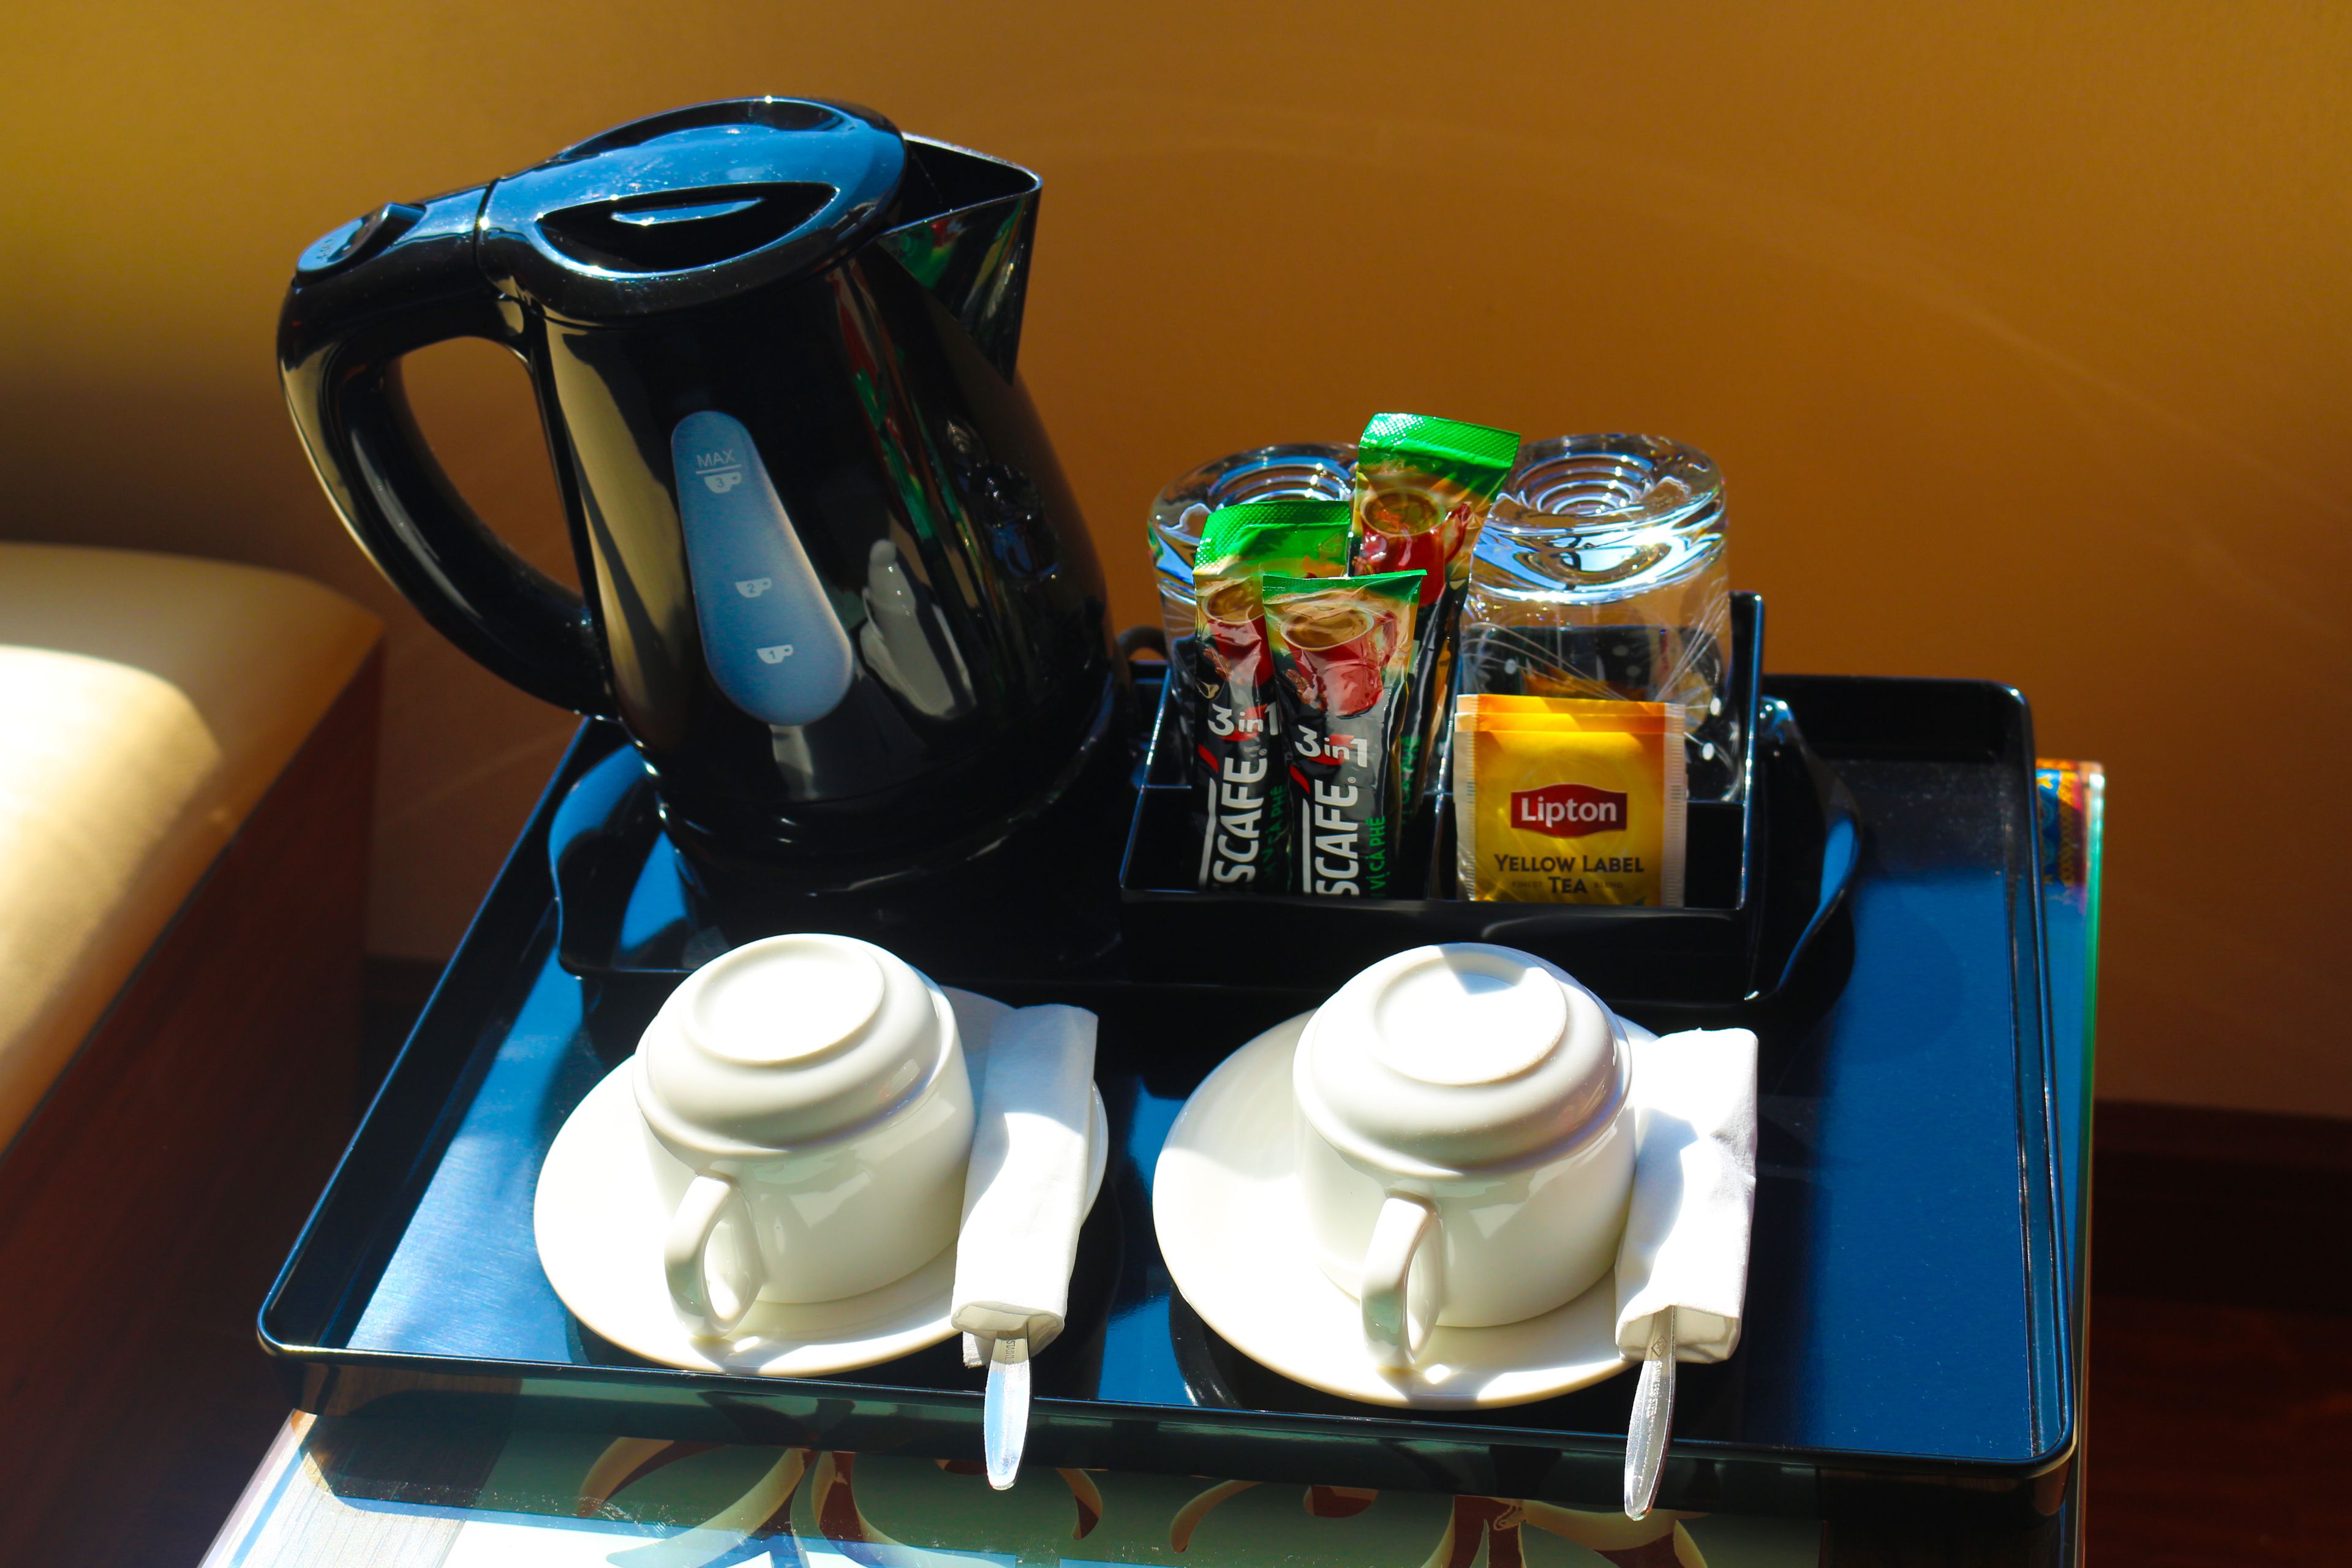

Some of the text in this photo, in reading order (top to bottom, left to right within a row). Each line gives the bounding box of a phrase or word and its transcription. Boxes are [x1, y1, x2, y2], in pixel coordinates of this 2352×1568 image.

[696, 449, 736, 469] MAX
[716, 477, 725, 489] 3
[746, 582, 756, 594] 2
[1202, 747, 1268, 884] SCAFÉ
[1521, 796, 1617, 828] Lipton
[1365, 815, 1386, 847] PHÊ
[1494, 854, 1645, 873] YELLOW LABEL
[1548, 876, 1588, 894] TEA
